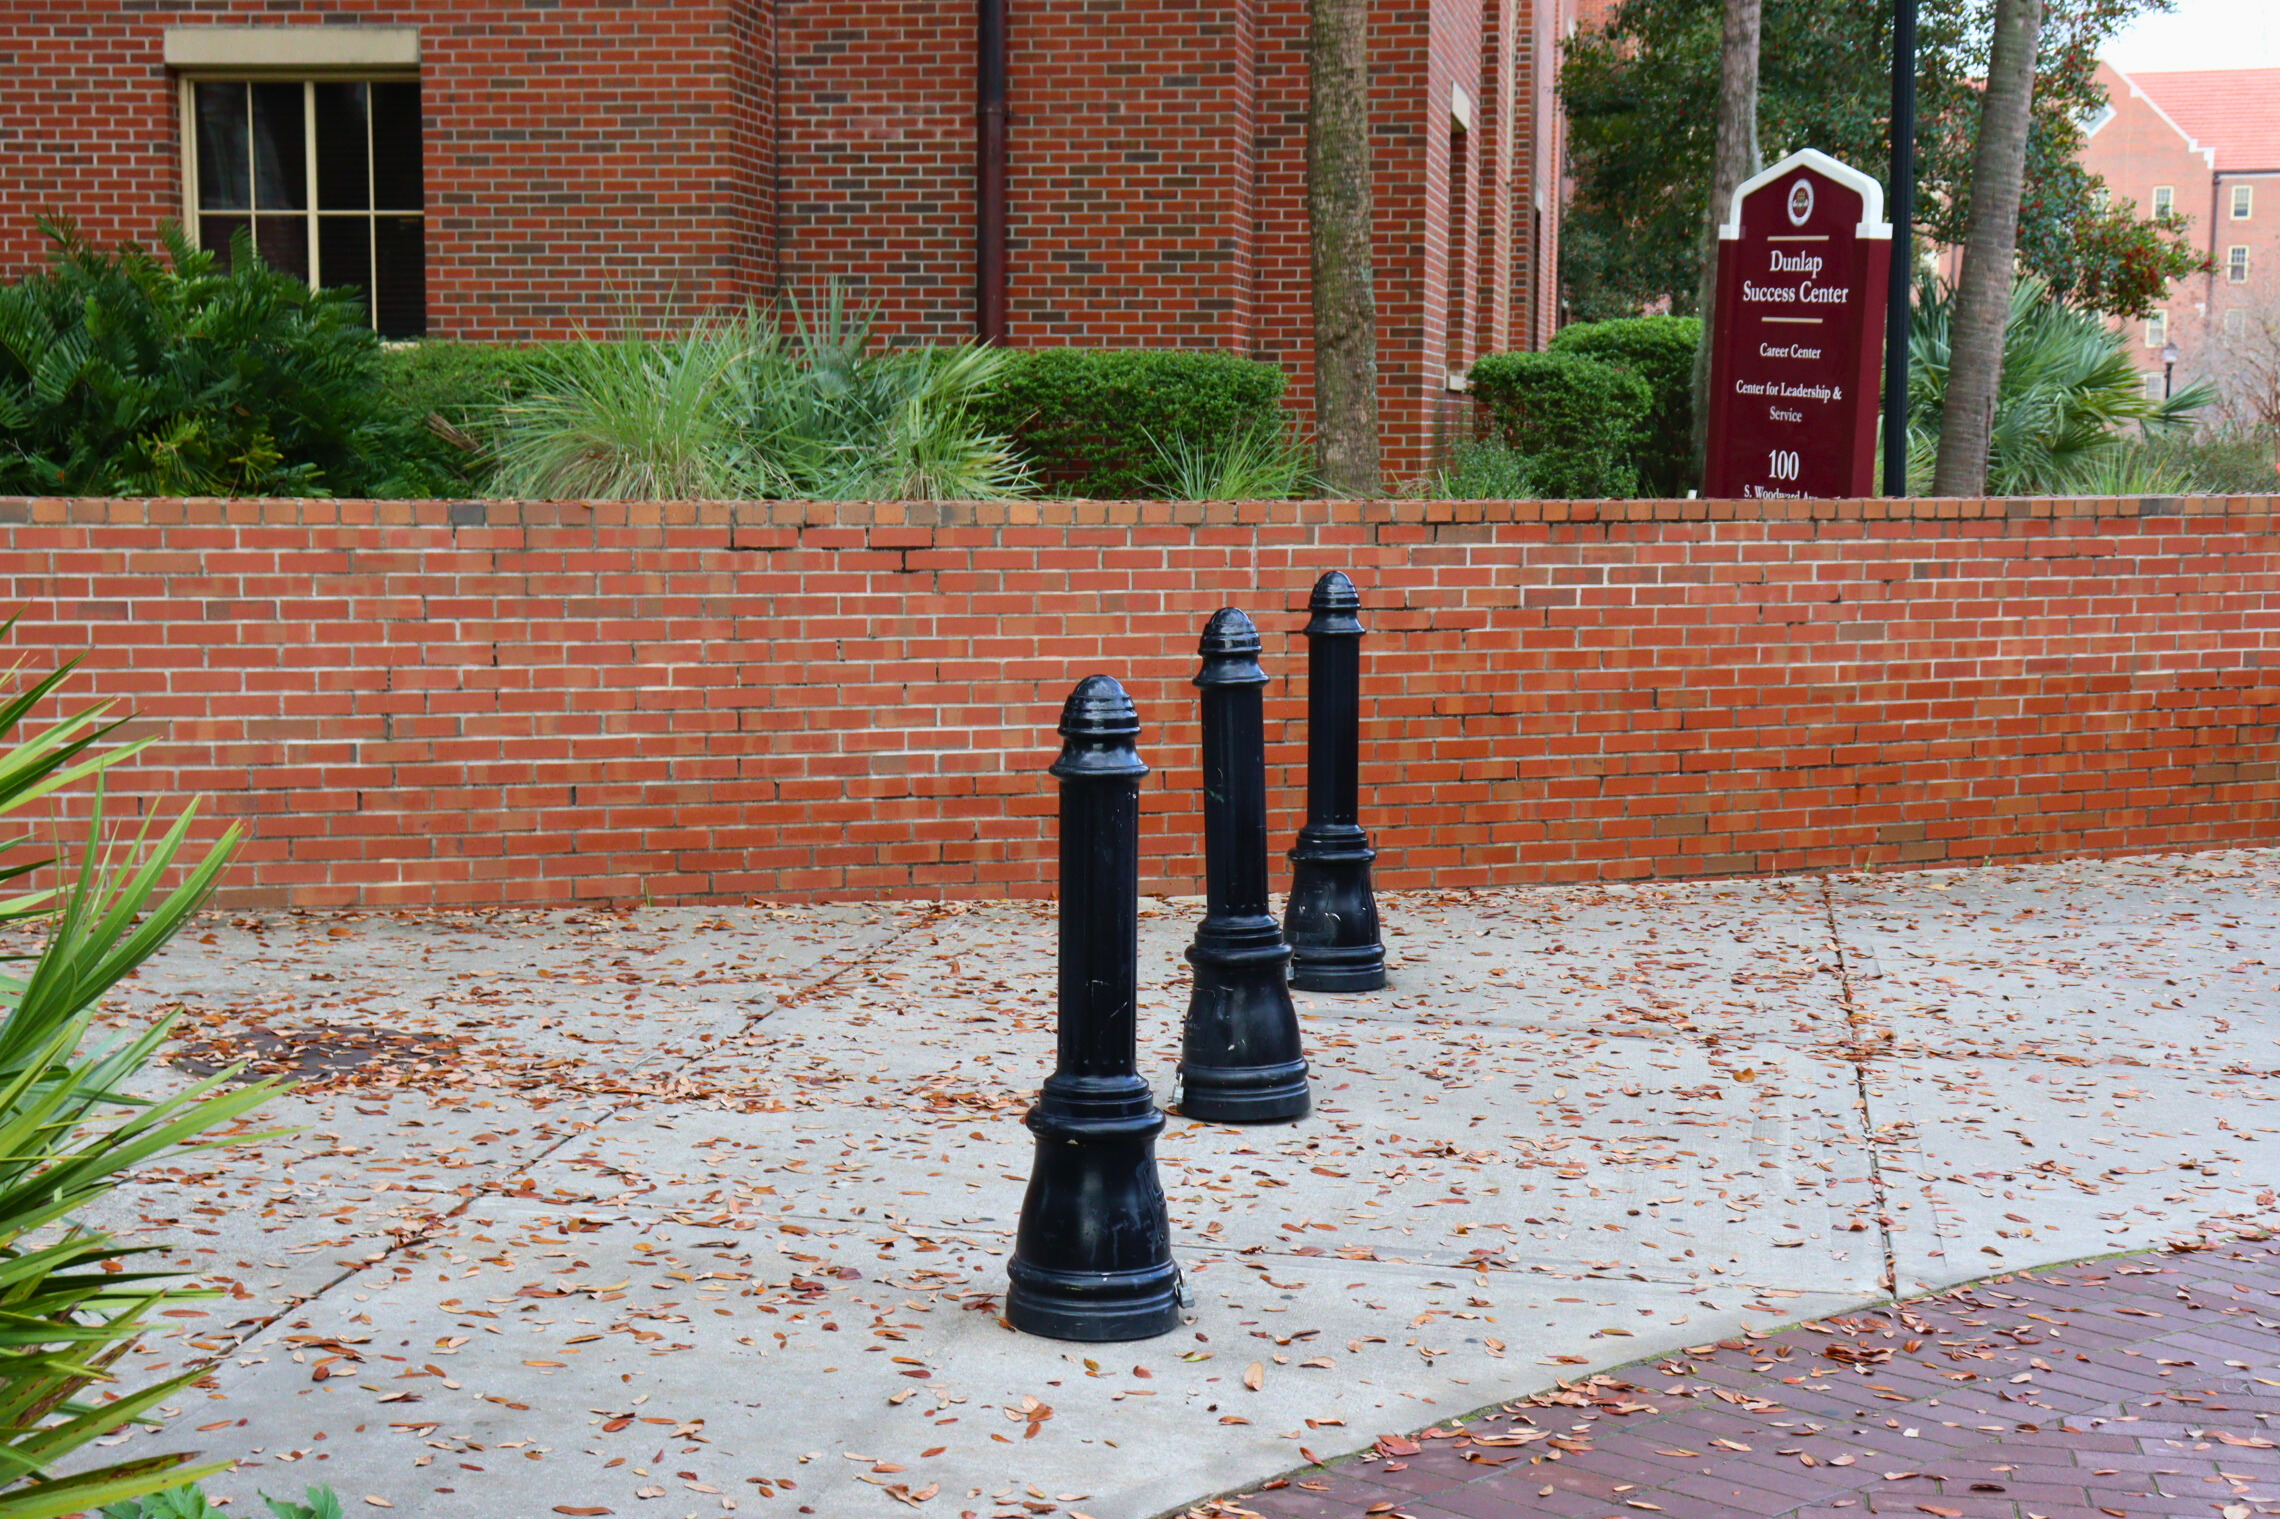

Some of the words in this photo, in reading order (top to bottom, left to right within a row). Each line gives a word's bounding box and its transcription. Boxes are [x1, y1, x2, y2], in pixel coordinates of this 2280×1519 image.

[1769, 250, 1823, 279] Dunlap
[1743, 280, 1796, 302] Success
[1799, 280, 1849, 303] Center
[1759, 342, 1789, 358] Career
[1790, 343, 1822, 359] Center
[1736, 379, 1765, 395] Center
[1766, 381, 1779, 396] for
[1780, 382, 1831, 403] Leadership
[1832, 386, 1842, 400] &
[1769, 405, 1803, 423] Service
[1768, 449, 1800, 481] 100
[1743, 484, 1753, 498] S.
